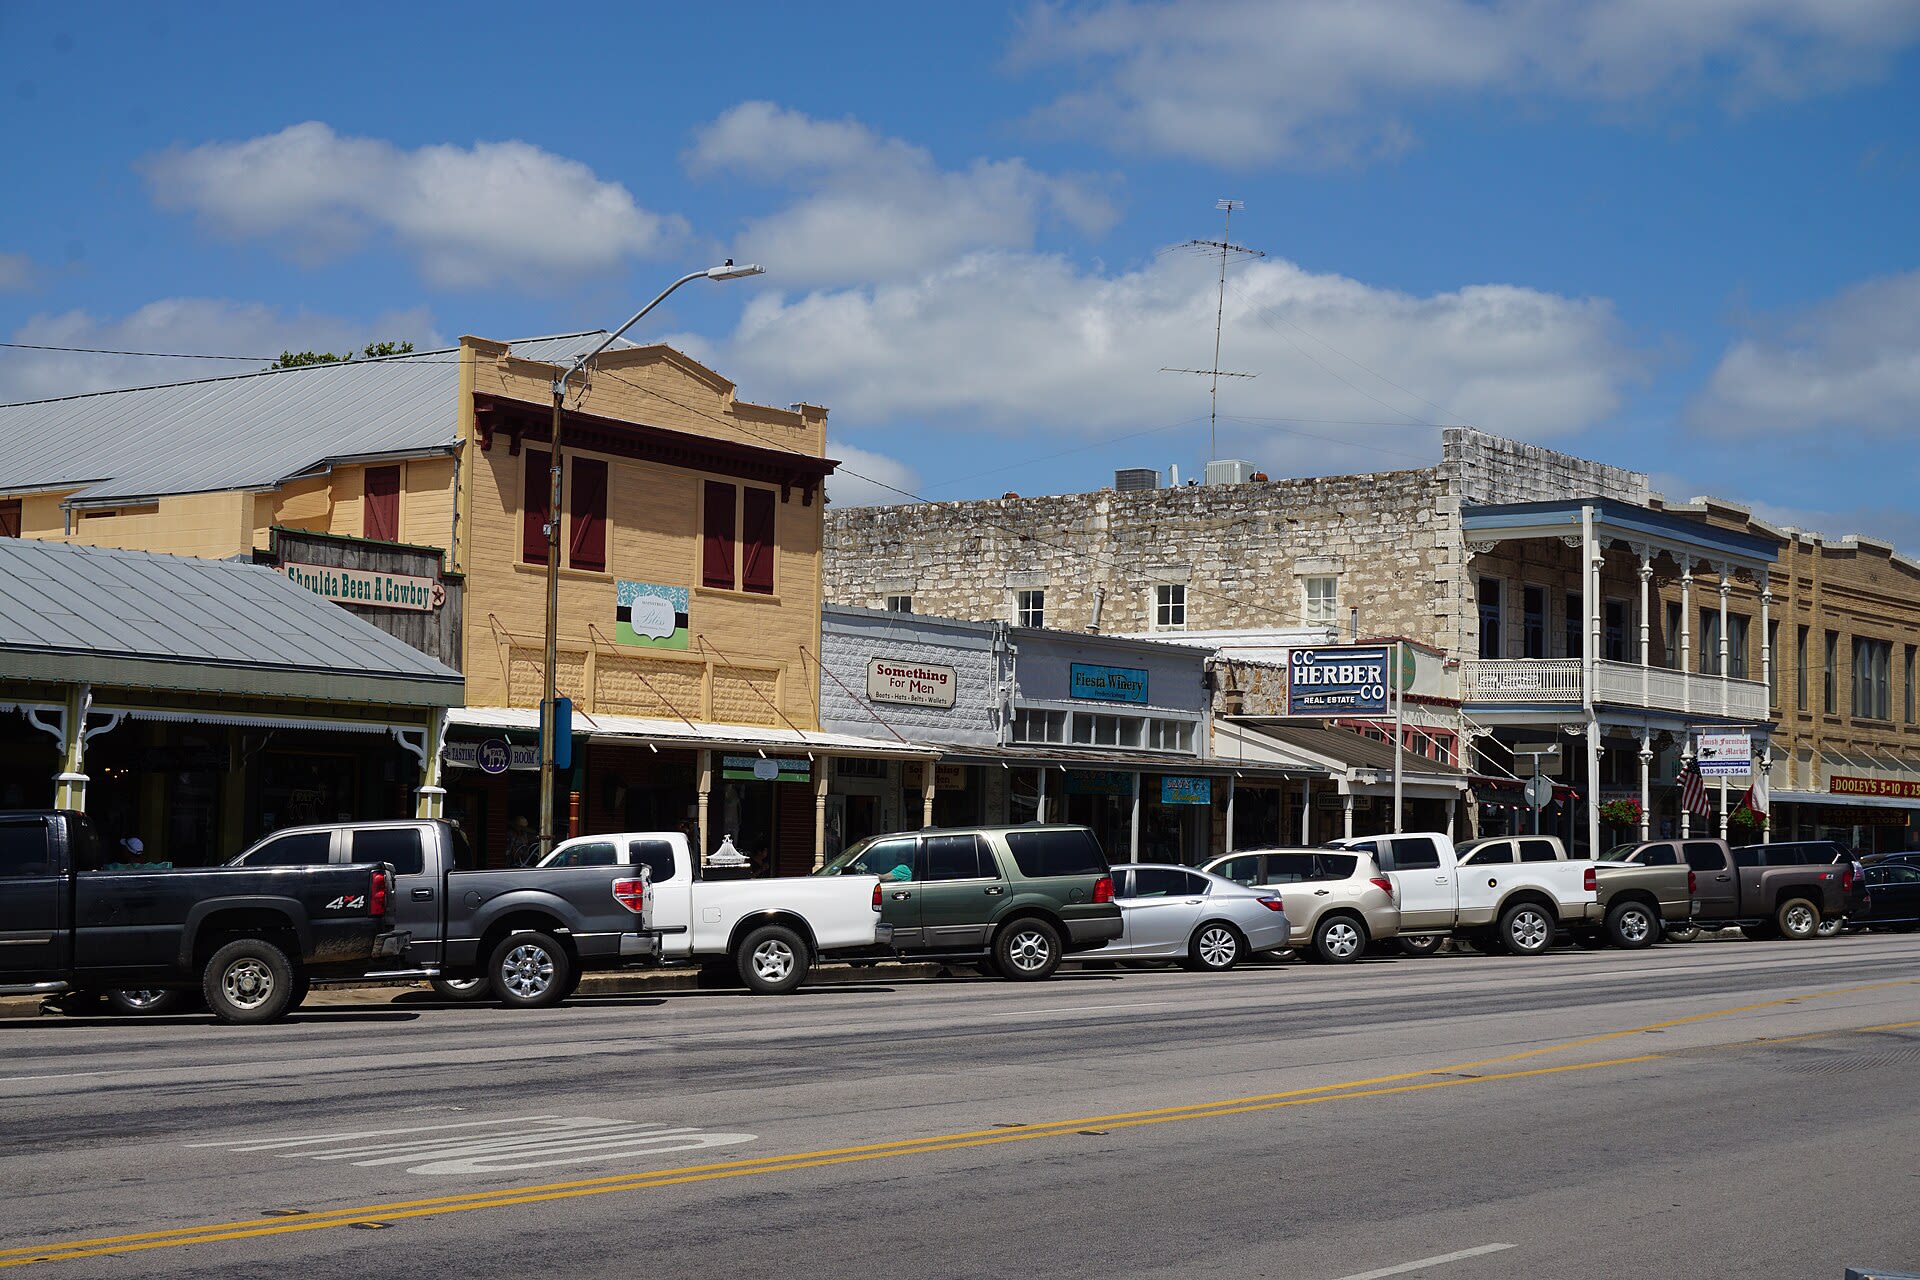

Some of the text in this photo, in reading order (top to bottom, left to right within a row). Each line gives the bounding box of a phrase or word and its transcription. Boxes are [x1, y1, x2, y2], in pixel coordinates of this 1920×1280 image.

[341, 573, 371, 600] Been
[374, 577, 382, 601] A
[385, 578, 430, 609] Cowboy
[1292, 651, 1314, 665] CC
[877, 664, 948, 685] Something
[1293, 665, 1382, 685] HERBER
[889, 677, 934, 694] For Men
[1075, 672, 1143, 700] Fiesta Winery
[1360, 685, 1385, 700] CO
[875, 691, 890, 699] Boots
[894, 693, 907, 701] Hats
[1327, 696, 1355, 704] ESTATE
[1699, 737, 1749, 747] Amish Furniture
[452, 747, 475, 761] TASTING
[514, 751, 535, 764] ROOM
[490, 749, 503, 757] FAT
[1725, 747, 1749, 755] Market
[1835, 779, 1877, 793] DOOLEY'S
